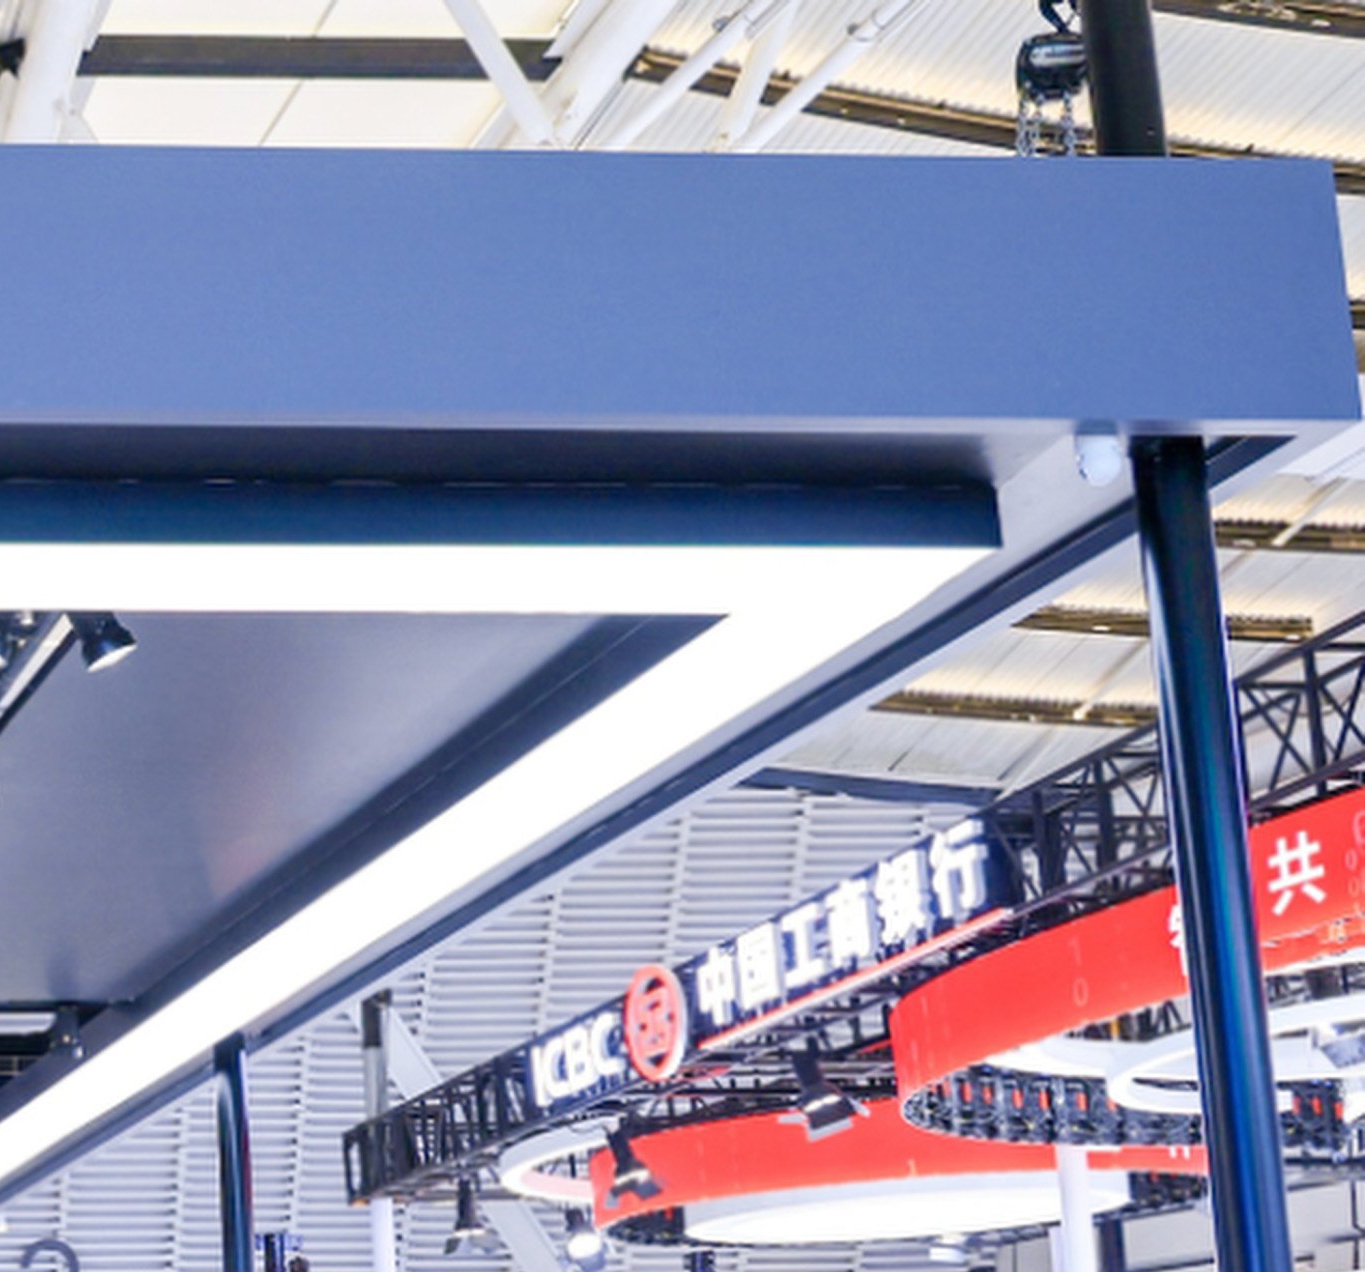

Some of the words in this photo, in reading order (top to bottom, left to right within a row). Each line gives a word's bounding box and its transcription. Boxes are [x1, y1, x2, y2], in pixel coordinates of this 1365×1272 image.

[697, 819, 990, 1025] 中国工商银行
[531, 1010, 626, 1108] ICBC
